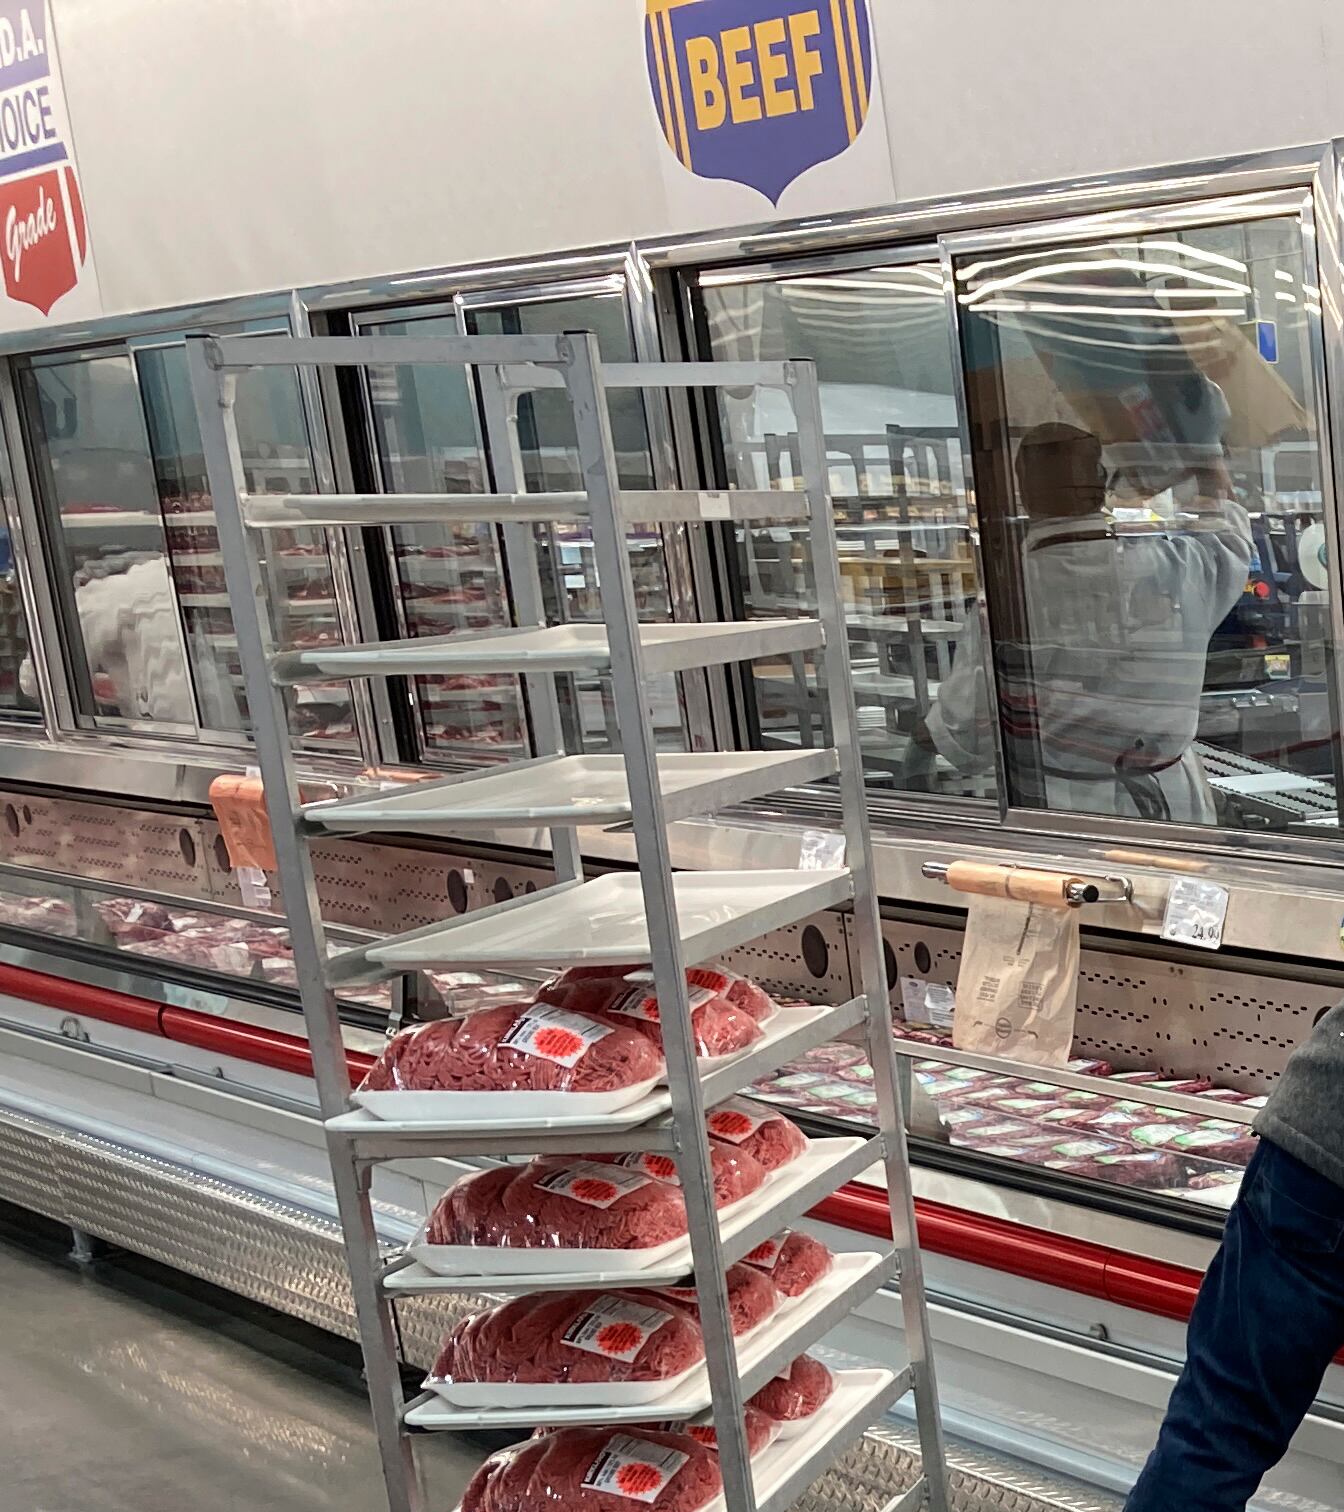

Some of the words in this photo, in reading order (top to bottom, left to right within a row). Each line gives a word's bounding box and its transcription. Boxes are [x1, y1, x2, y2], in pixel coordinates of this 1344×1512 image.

[0, 85, 56, 152] OICE
[685, 9, 823, 131] BEEF
[5, 185, 56, 283] Grade
